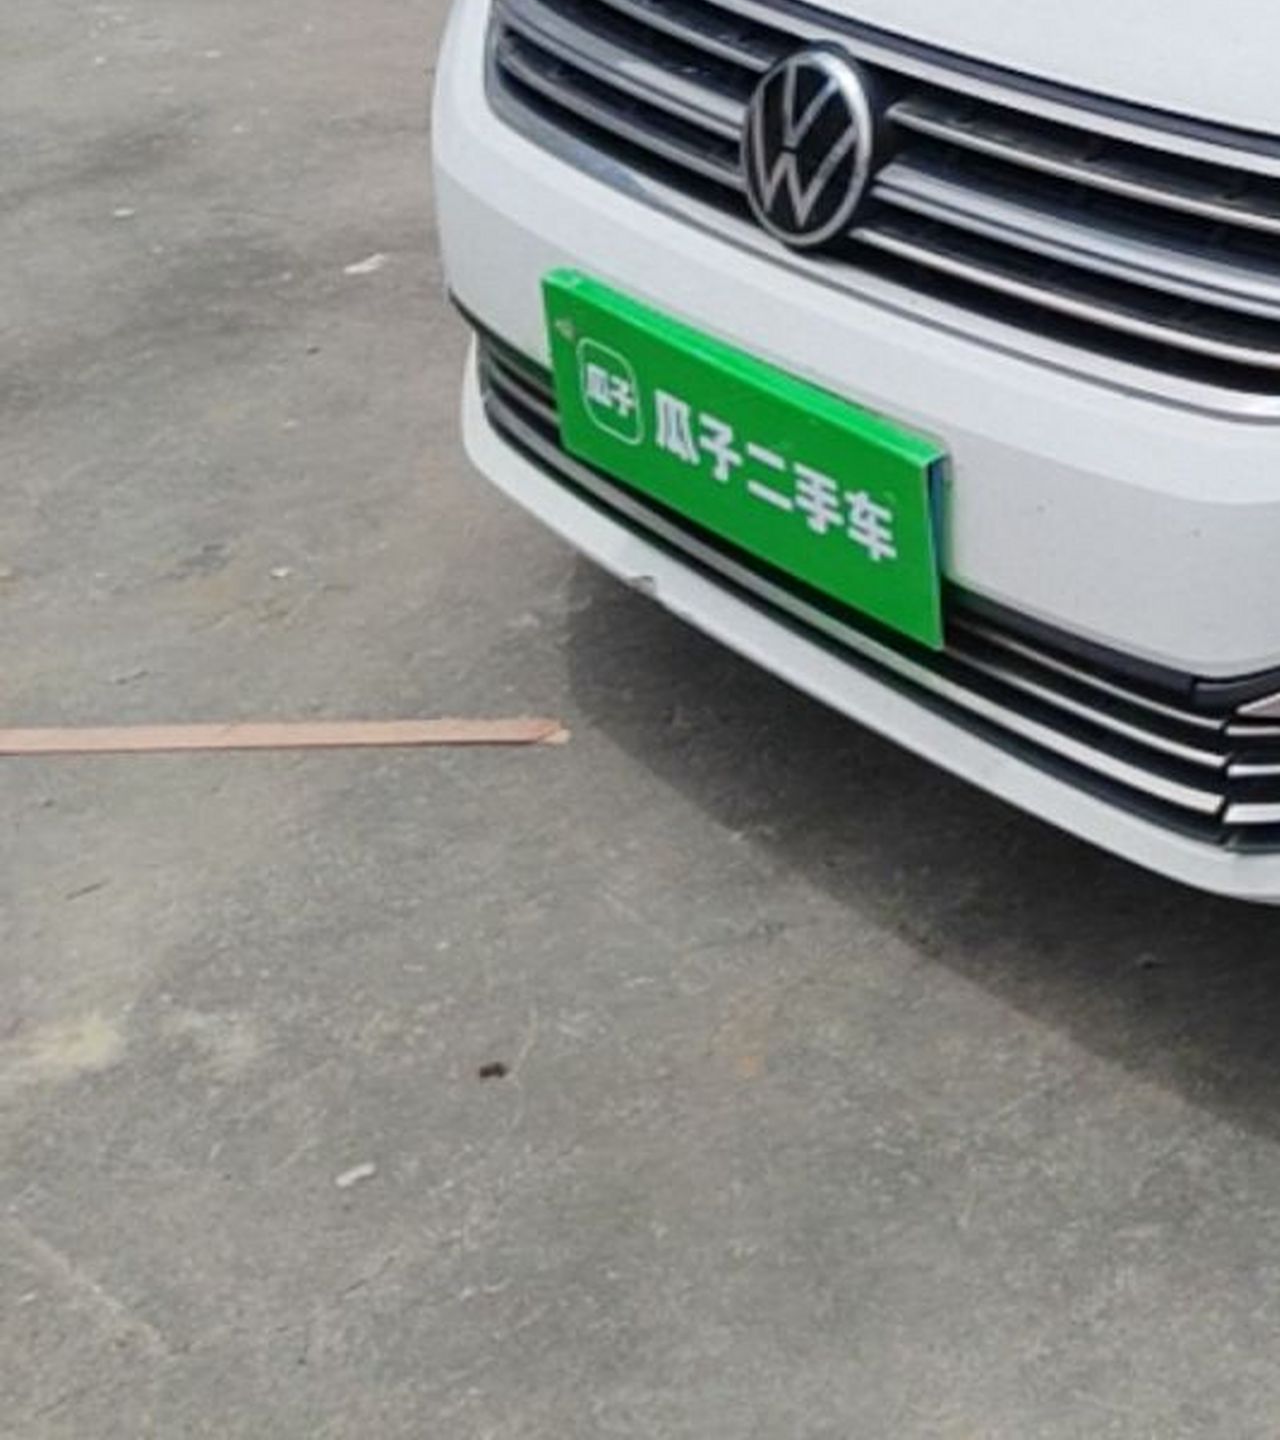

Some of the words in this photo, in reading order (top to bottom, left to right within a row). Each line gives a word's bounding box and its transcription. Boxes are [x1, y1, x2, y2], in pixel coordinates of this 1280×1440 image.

[653, 388, 897, 561] 瓜子二手车
